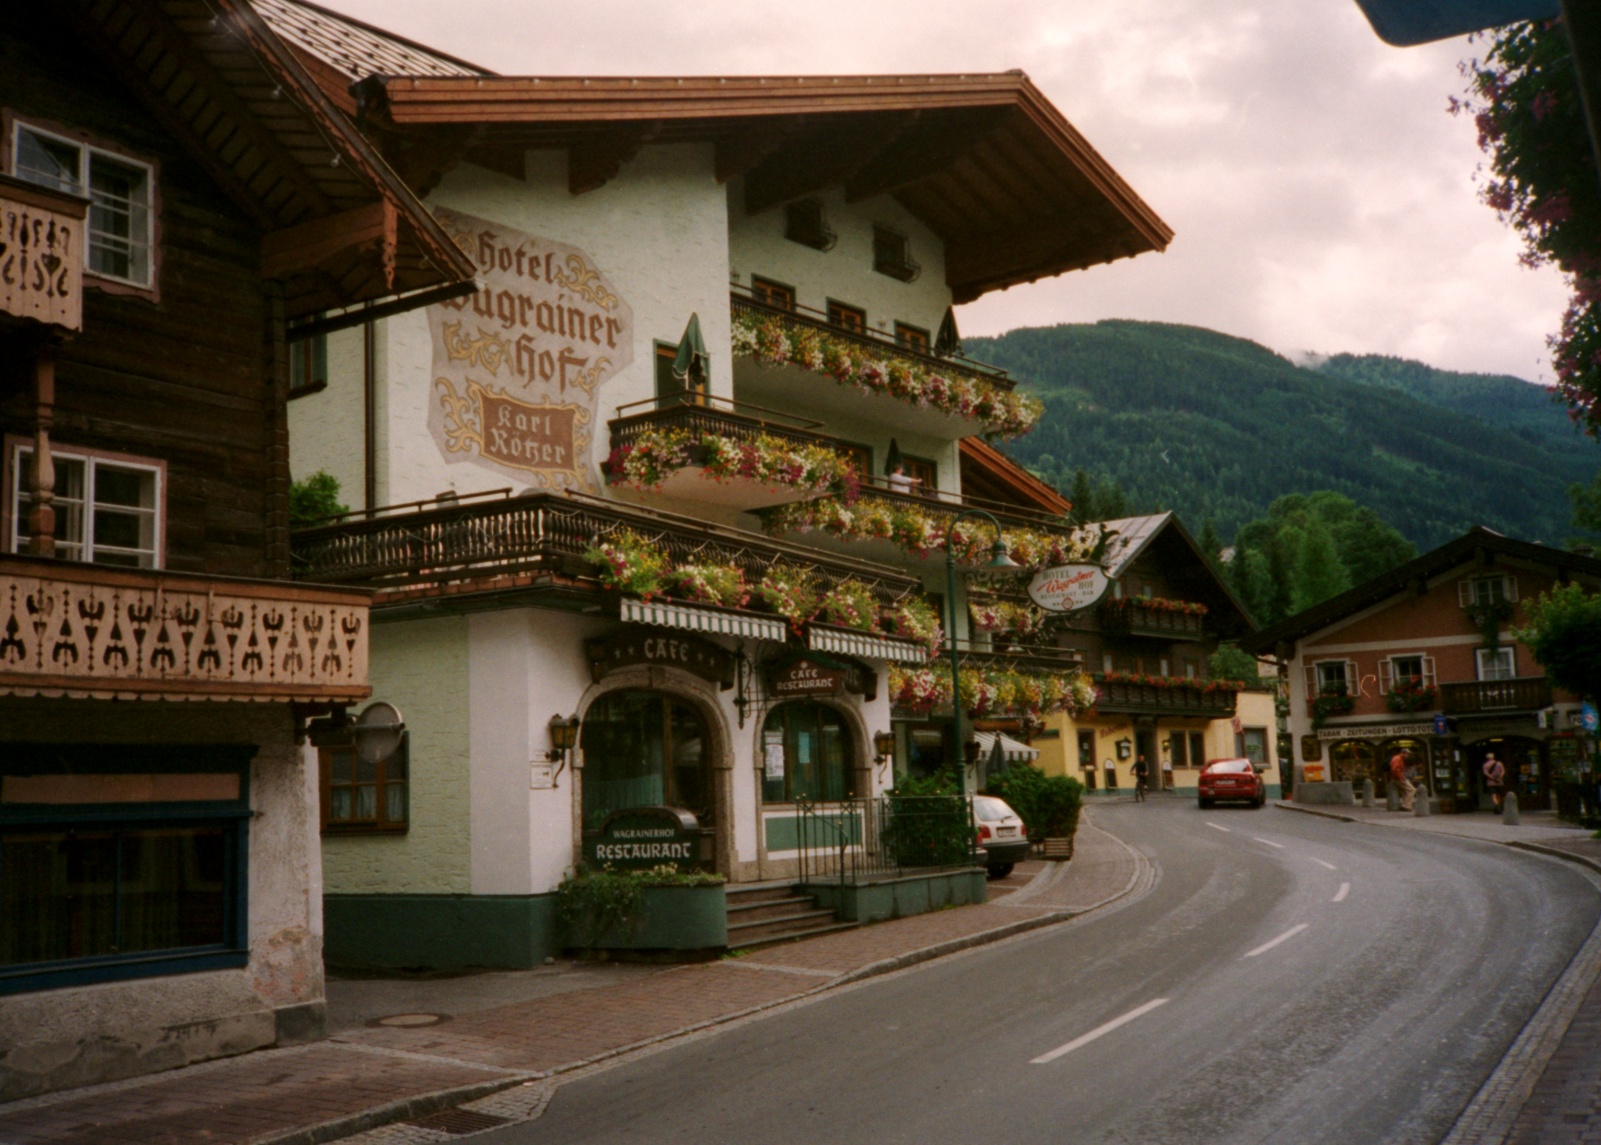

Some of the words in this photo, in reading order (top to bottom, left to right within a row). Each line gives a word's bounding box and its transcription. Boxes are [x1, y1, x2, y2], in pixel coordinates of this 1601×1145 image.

[477, 231, 555, 284] Hotel
[497, 404, 552, 436] Karl
[1043, 570, 1070, 580] HOTEL
[1078, 580, 1095, 590] HOF
[777, 678, 834, 691] RESTAURANT
[1318, 730, 1342, 738] TABAK
[1346, 728, 1388, 737] ZEITUNGEN
[613, 828, 675, 839] WAGRAINERHOF
[596, 842, 691, 859] RESTAURANT
